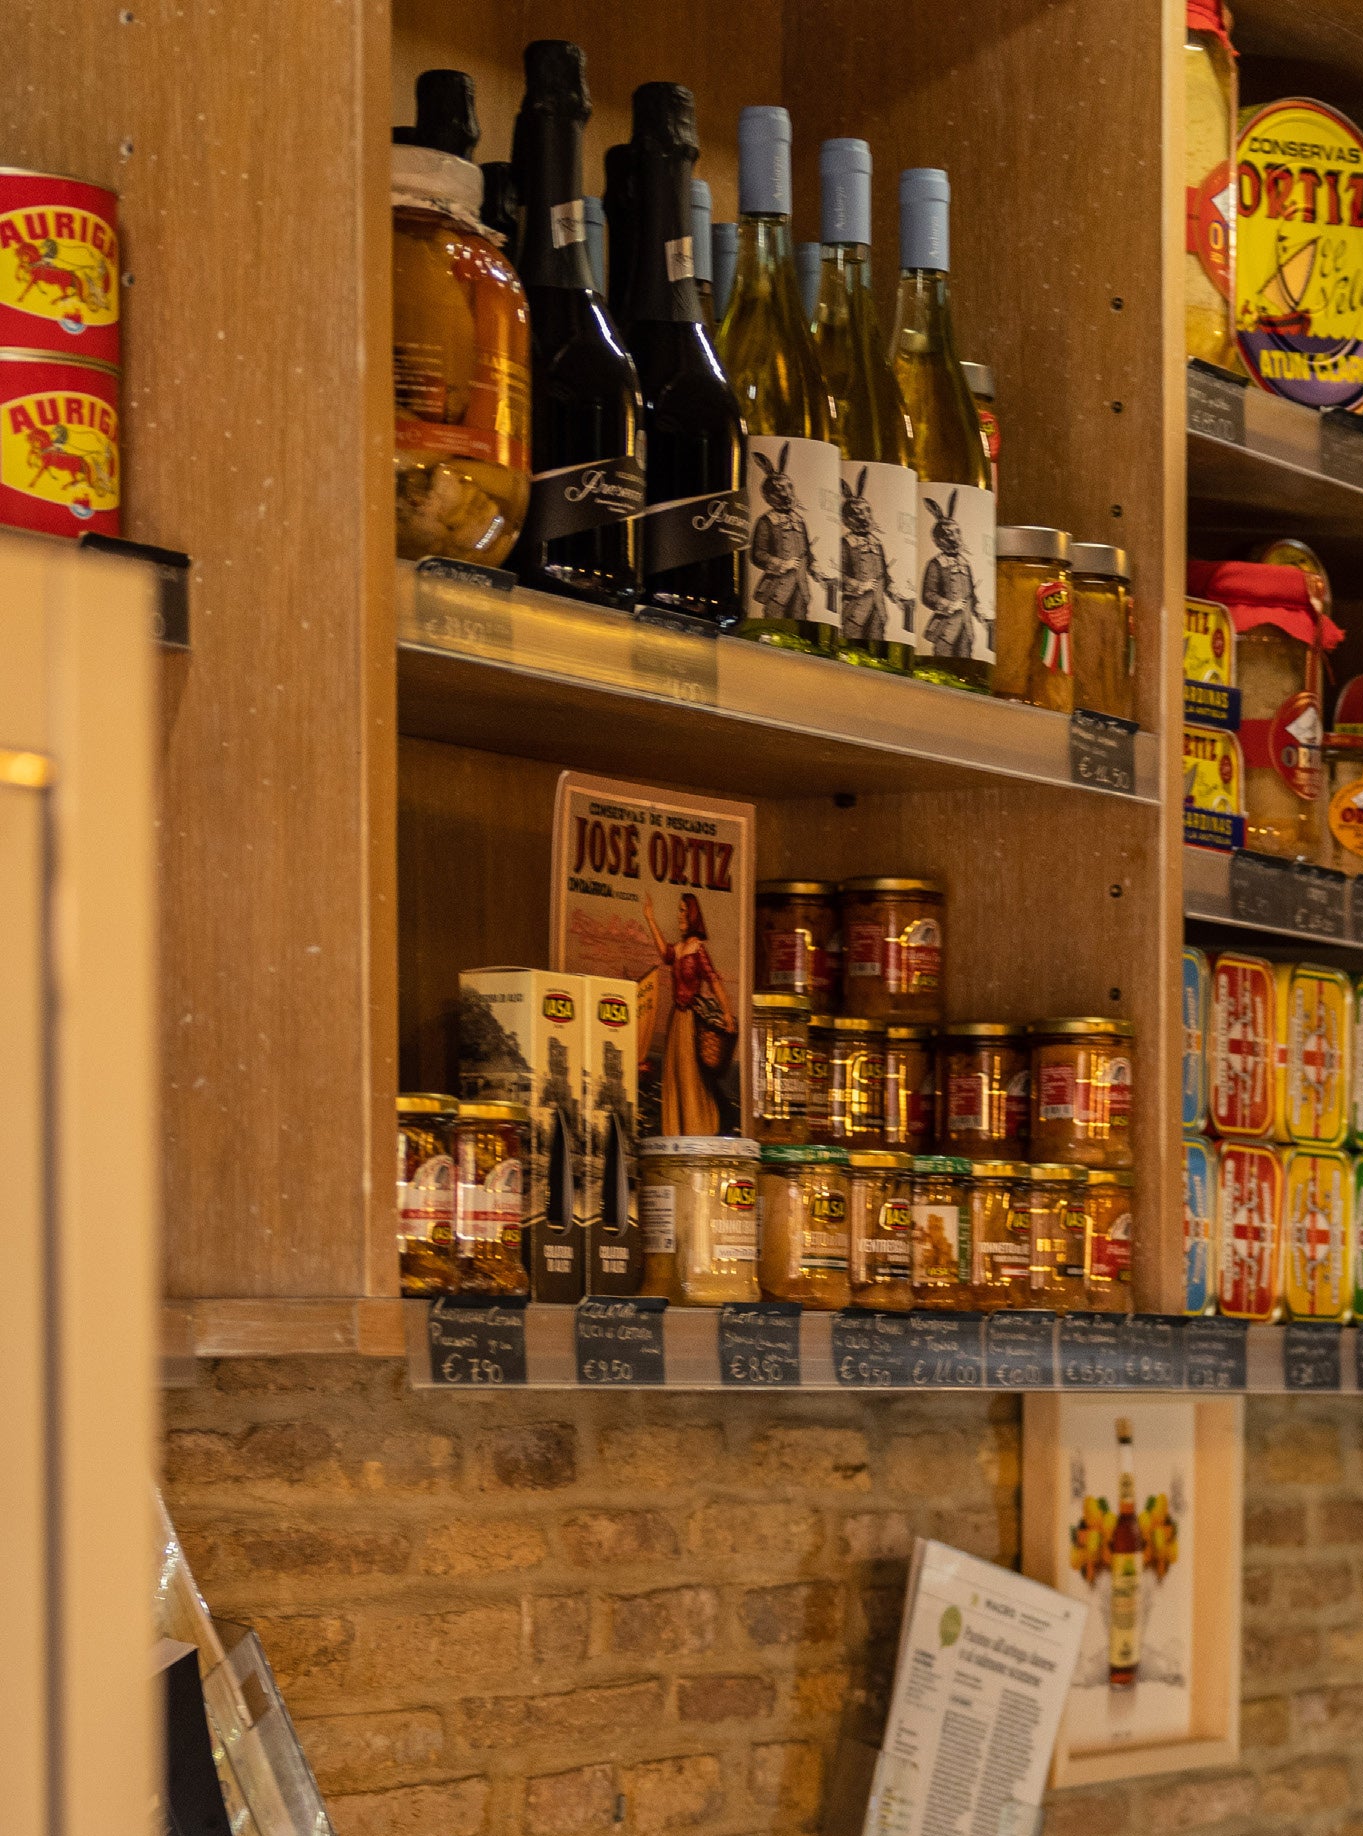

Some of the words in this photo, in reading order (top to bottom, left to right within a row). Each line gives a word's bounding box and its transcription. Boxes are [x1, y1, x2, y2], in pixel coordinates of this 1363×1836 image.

[1249, 137, 1361, 164] CONSERVAS
[9, 397, 119, 442] AURIG
[650, 831, 734, 893] ORTIZ
[545, 999, 573, 1018] IASA
[602, 1004, 628, 1022] IASA
